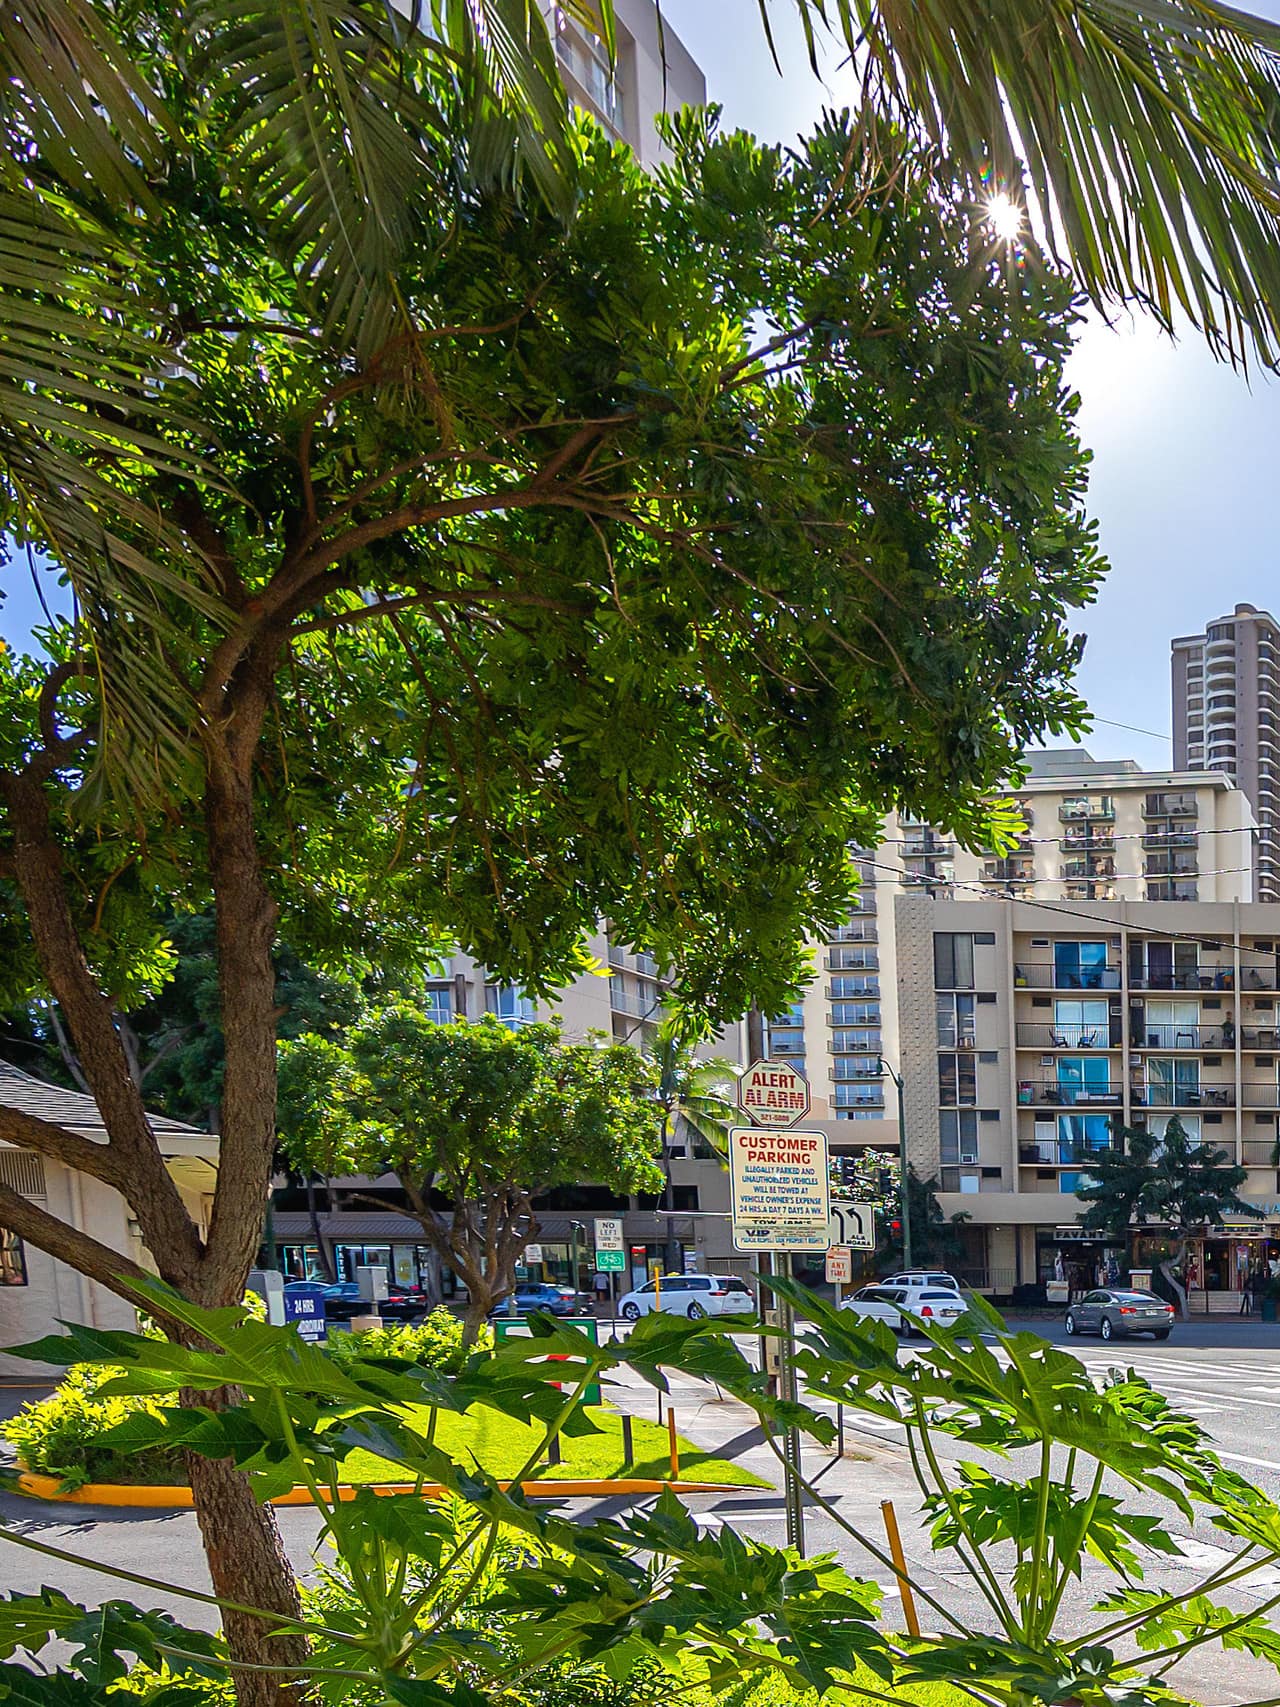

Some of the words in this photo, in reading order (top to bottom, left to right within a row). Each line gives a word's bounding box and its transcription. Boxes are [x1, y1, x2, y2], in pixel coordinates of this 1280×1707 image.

[752, 1072, 796, 1088] ALERT
[745, 1089, 804, 1109] ALARM
[739, 1136, 818, 1151] CUSTOMER
[748, 1151, 811, 1164] PARKING
[776, 1166, 799, 1174] PARKED
[742, 1176, 790, 1184] UNAUTHORIZED
[792, 1177, 818, 1185] VEHICLES
[766, 1196, 794, 1204] OWNER'S
[796, 1197, 821, 1205] EXPENSE
[294, 1299, 302, 1313] 24
[302, 1299, 314, 1313] HRS
